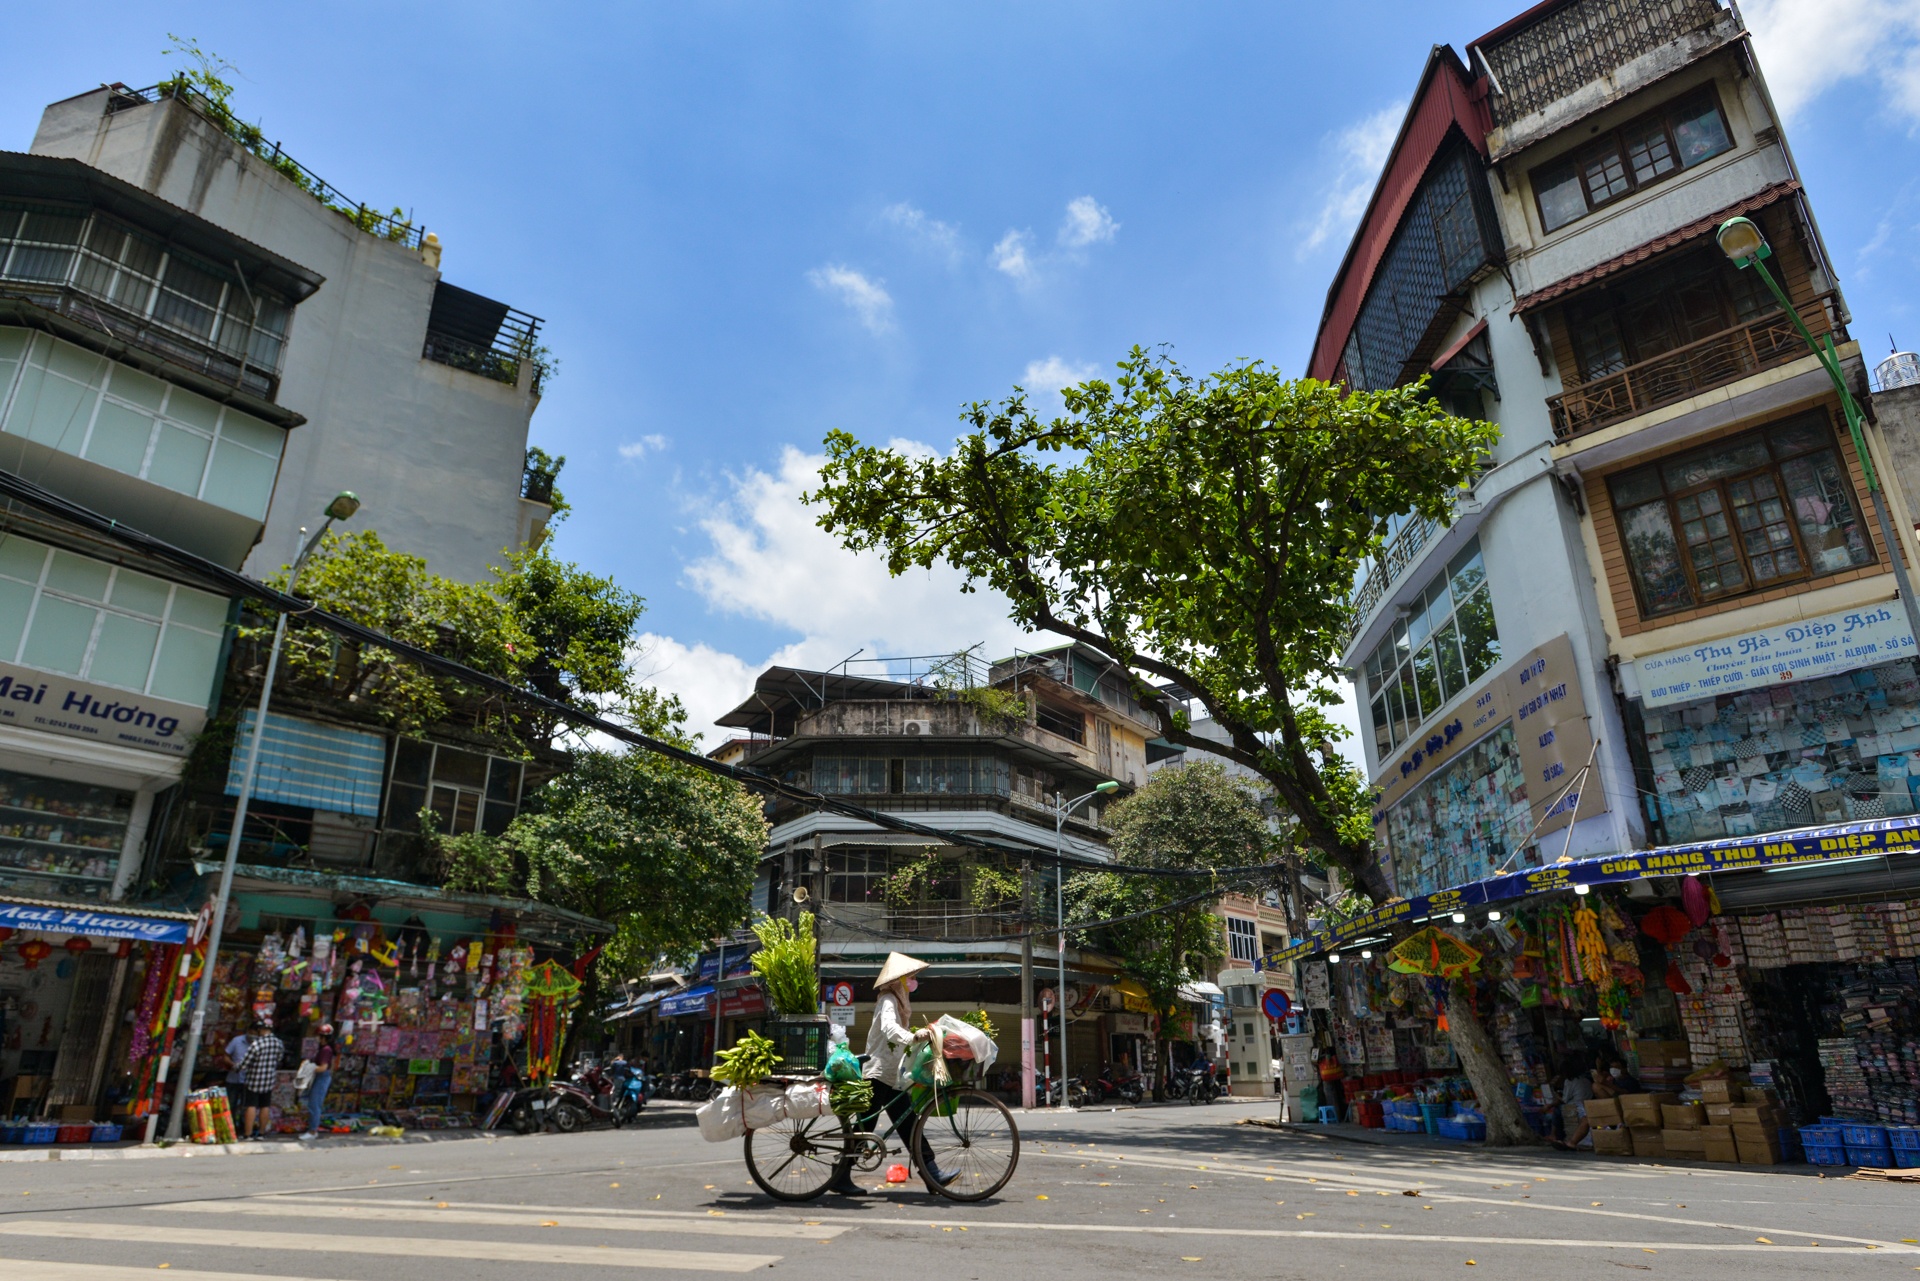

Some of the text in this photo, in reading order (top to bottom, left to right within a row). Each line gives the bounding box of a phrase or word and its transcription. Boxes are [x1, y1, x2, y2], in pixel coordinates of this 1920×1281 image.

[1644, 659, 1664, 671] CỬA
[1665, 654, 1692, 667] HÀNG
[1693, 646, 1732, 662] Thu
[1738, 634, 1771, 655] Hà
[1785, 622, 1837, 643] Diệp
[1844, 608, 1892, 632] Anh
[1668, 680, 1691, 695] THIẾP
[1698, 674, 1721, 688] THIẾP
[1790, 658, 1810, 670] SINH
[1812, 650, 1836, 666] NHẬT
[1845, 643, 1878, 659] ALBUM
[1780, 670, 1793, 681] 39
[1549, 683, 1567, 702] NHẬT
[61, 690, 179, 737] Hương
[1601, 859, 1642, 875] CỬA
[1647, 851, 1705, 868] HÀNG
[1710, 846, 1757, 862] THU
[1764, 841, 1797, 857] HÀ
[1820, 832, 1877, 851] DIỆP
[1722, 859, 1761, 869] ALBUM
[1537, 871, 1560, 881] 34A
[1436, 893, 1453, 901] 34A
[1395, 902, 1411, 915] ANH
[61, 912, 171, 935] Hương
